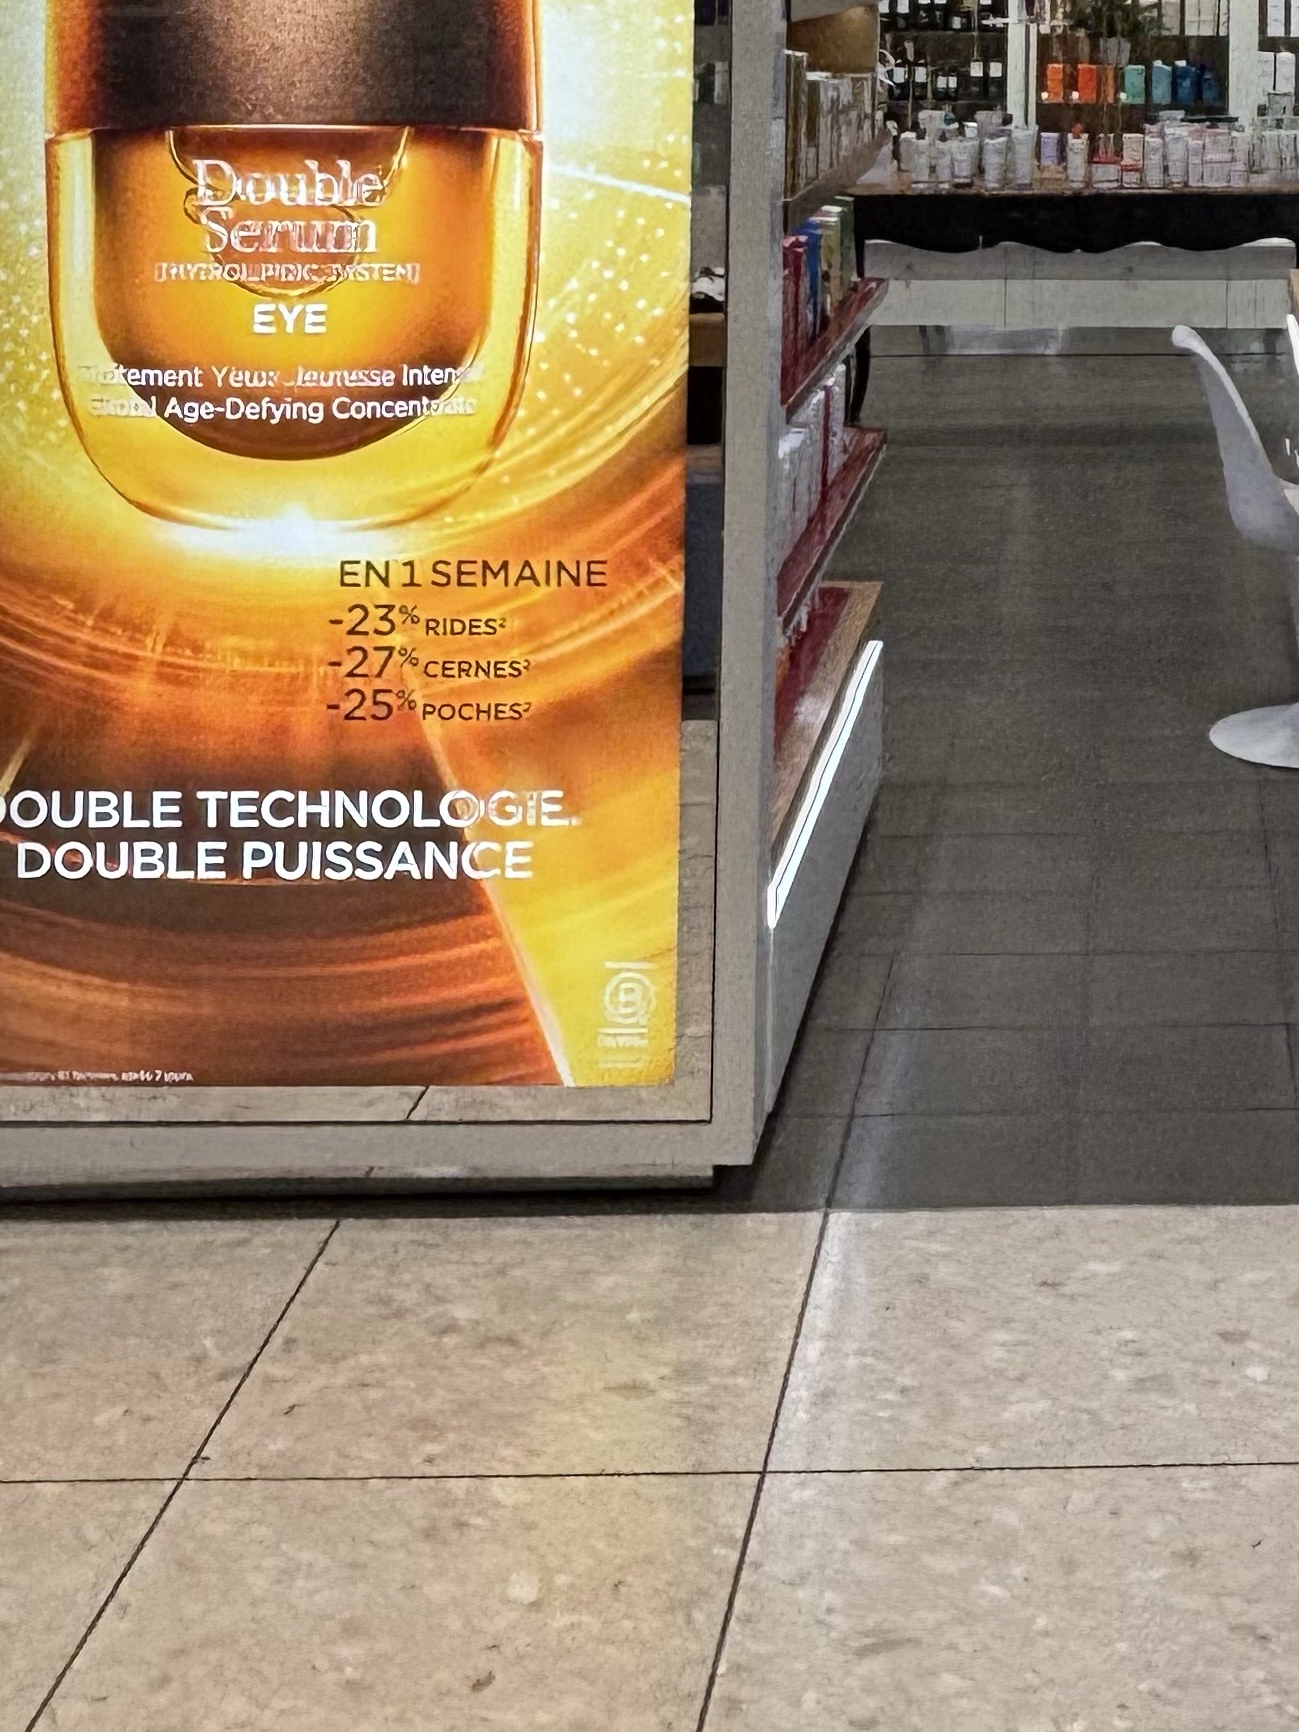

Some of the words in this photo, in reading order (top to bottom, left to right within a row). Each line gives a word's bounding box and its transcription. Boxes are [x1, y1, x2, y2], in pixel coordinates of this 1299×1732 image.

[192, 159, 388, 207] Double
[199, 206, 378, 254] Serum
[253, 303, 328, 334] EYE
[211, 365, 280, 387] Yeux
[164, 396, 324, 424] Age-Defying
[339, 560, 390, 588] EN
[402, 560, 422, 588] 1
[431, 560, 608, 588] SEMAINE
[328, 604, 421, 636] -23%
[327, 646, 419, 678] -27%
[326, 689, 418, 721] -25%
[0, 789, 182, 828] OUBLE
[17, 841, 228, 879] DOUBLE
[243, 840, 534, 880] PUISSANCE
